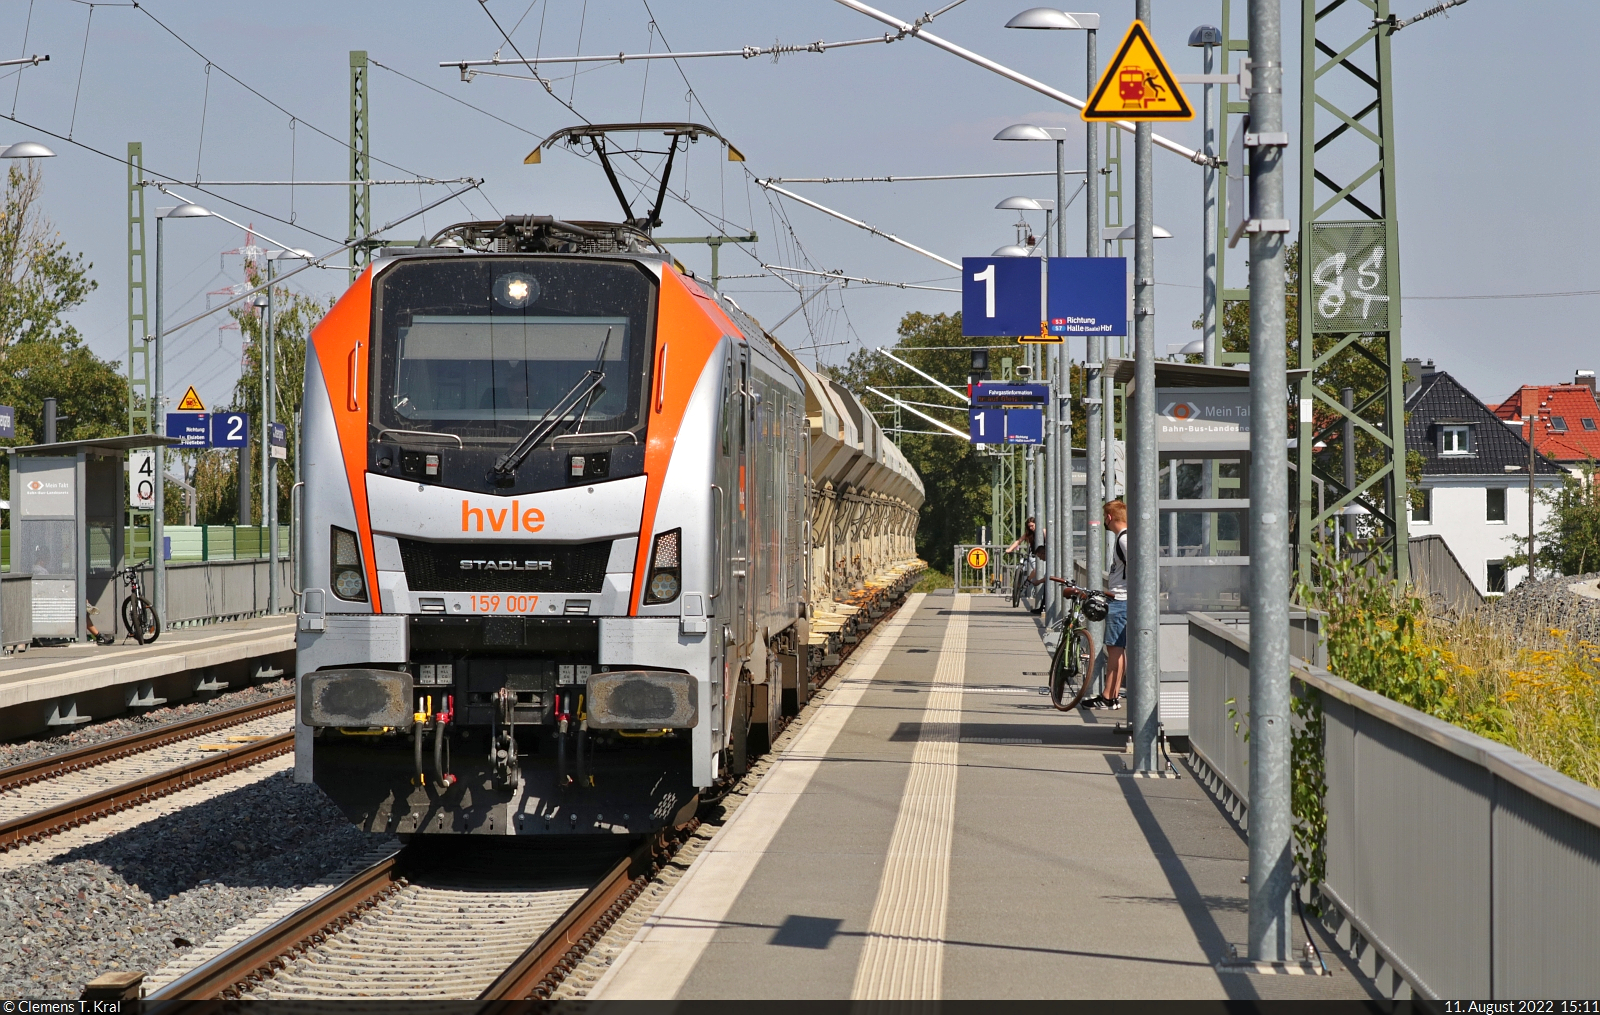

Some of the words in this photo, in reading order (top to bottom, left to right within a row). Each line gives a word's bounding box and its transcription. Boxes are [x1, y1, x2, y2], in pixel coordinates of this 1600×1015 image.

[973, 264, 995, 318] 1
[1066, 316, 1096, 325] Richtung
[1066, 324, 1084, 332] Halle
[1100, 324, 1112, 332] Hbf
[1205, 406, 1232, 417] Mein
[226, 415, 243, 441] 2
[974, 411, 985, 436] 1
[461, 499, 546, 533] hvle
[459, 560, 552, 571] STADLER
[470, 595, 500, 612] 159
[506, 595, 539, 612] 007
